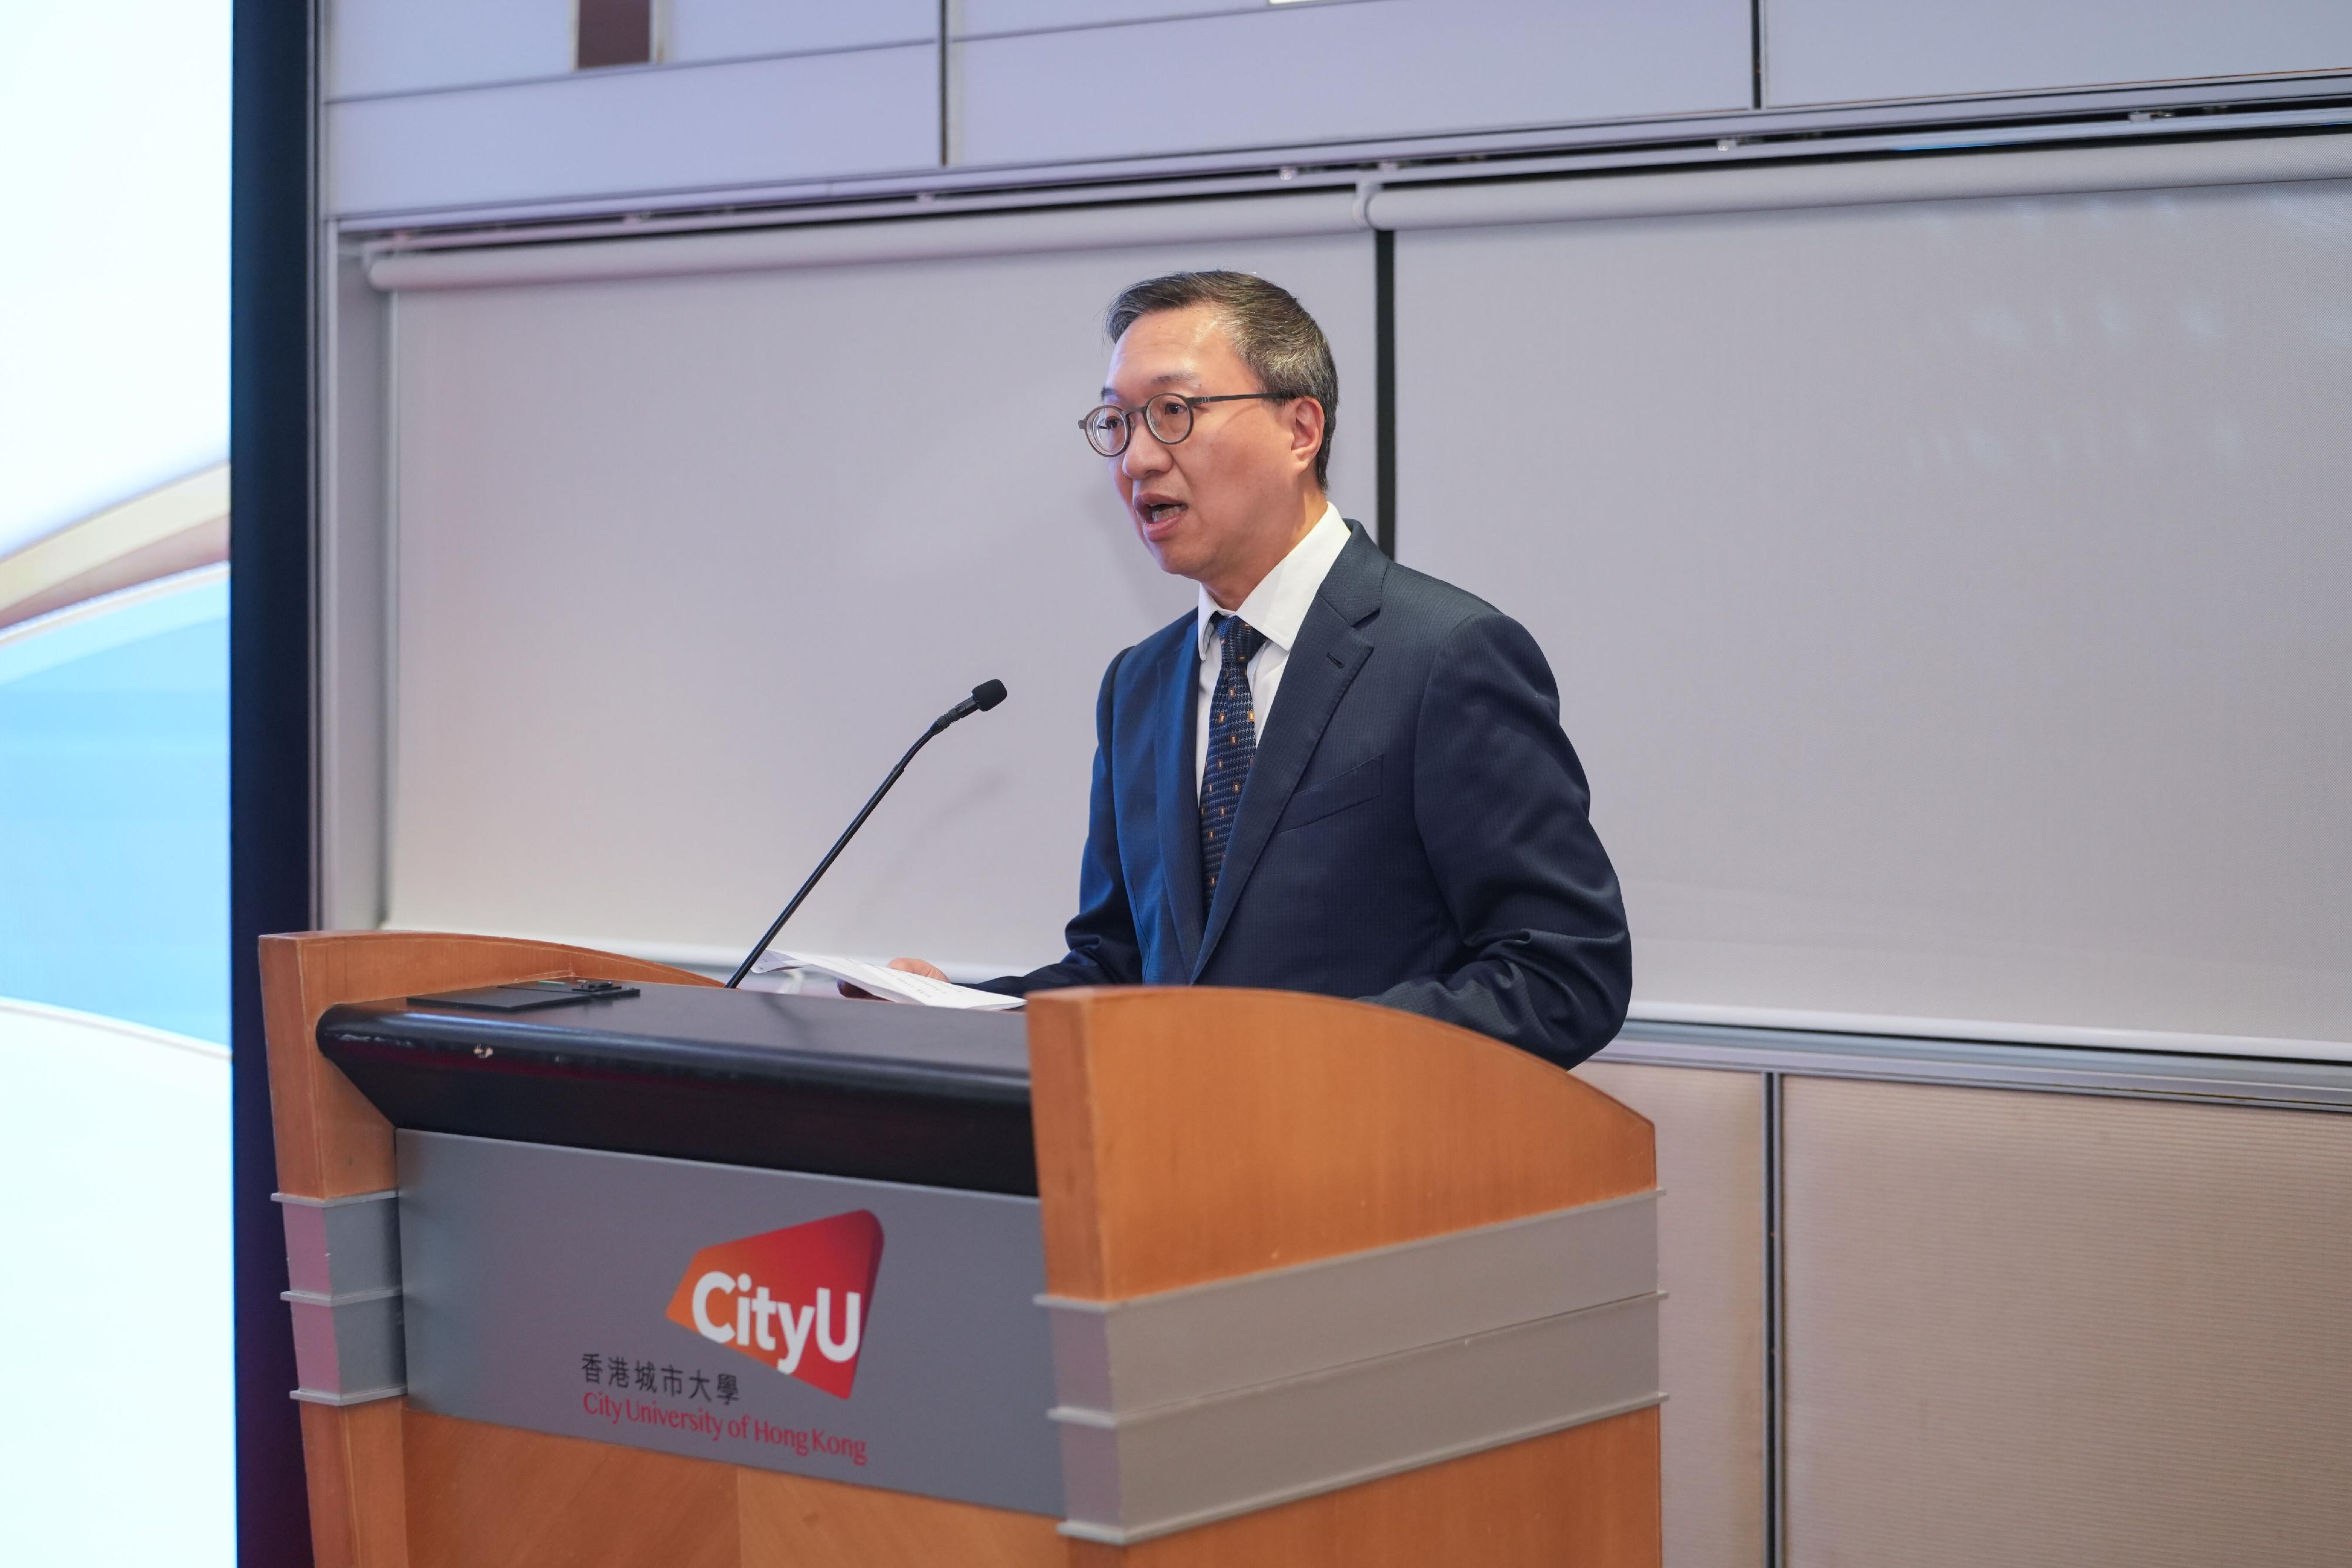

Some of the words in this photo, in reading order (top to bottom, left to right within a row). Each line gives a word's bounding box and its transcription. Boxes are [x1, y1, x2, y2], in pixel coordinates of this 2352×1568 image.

[692, 1271, 861, 1375] CityU
[582, 1353, 740, 1405] 香港城市大學
[583, 1391, 622, 1425] City
[626, 1399, 723, 1442] University
[727, 1415, 751, 1439] of
[754, 1420, 809, 1457] Hong
[812, 1428, 867, 1466] Kong
